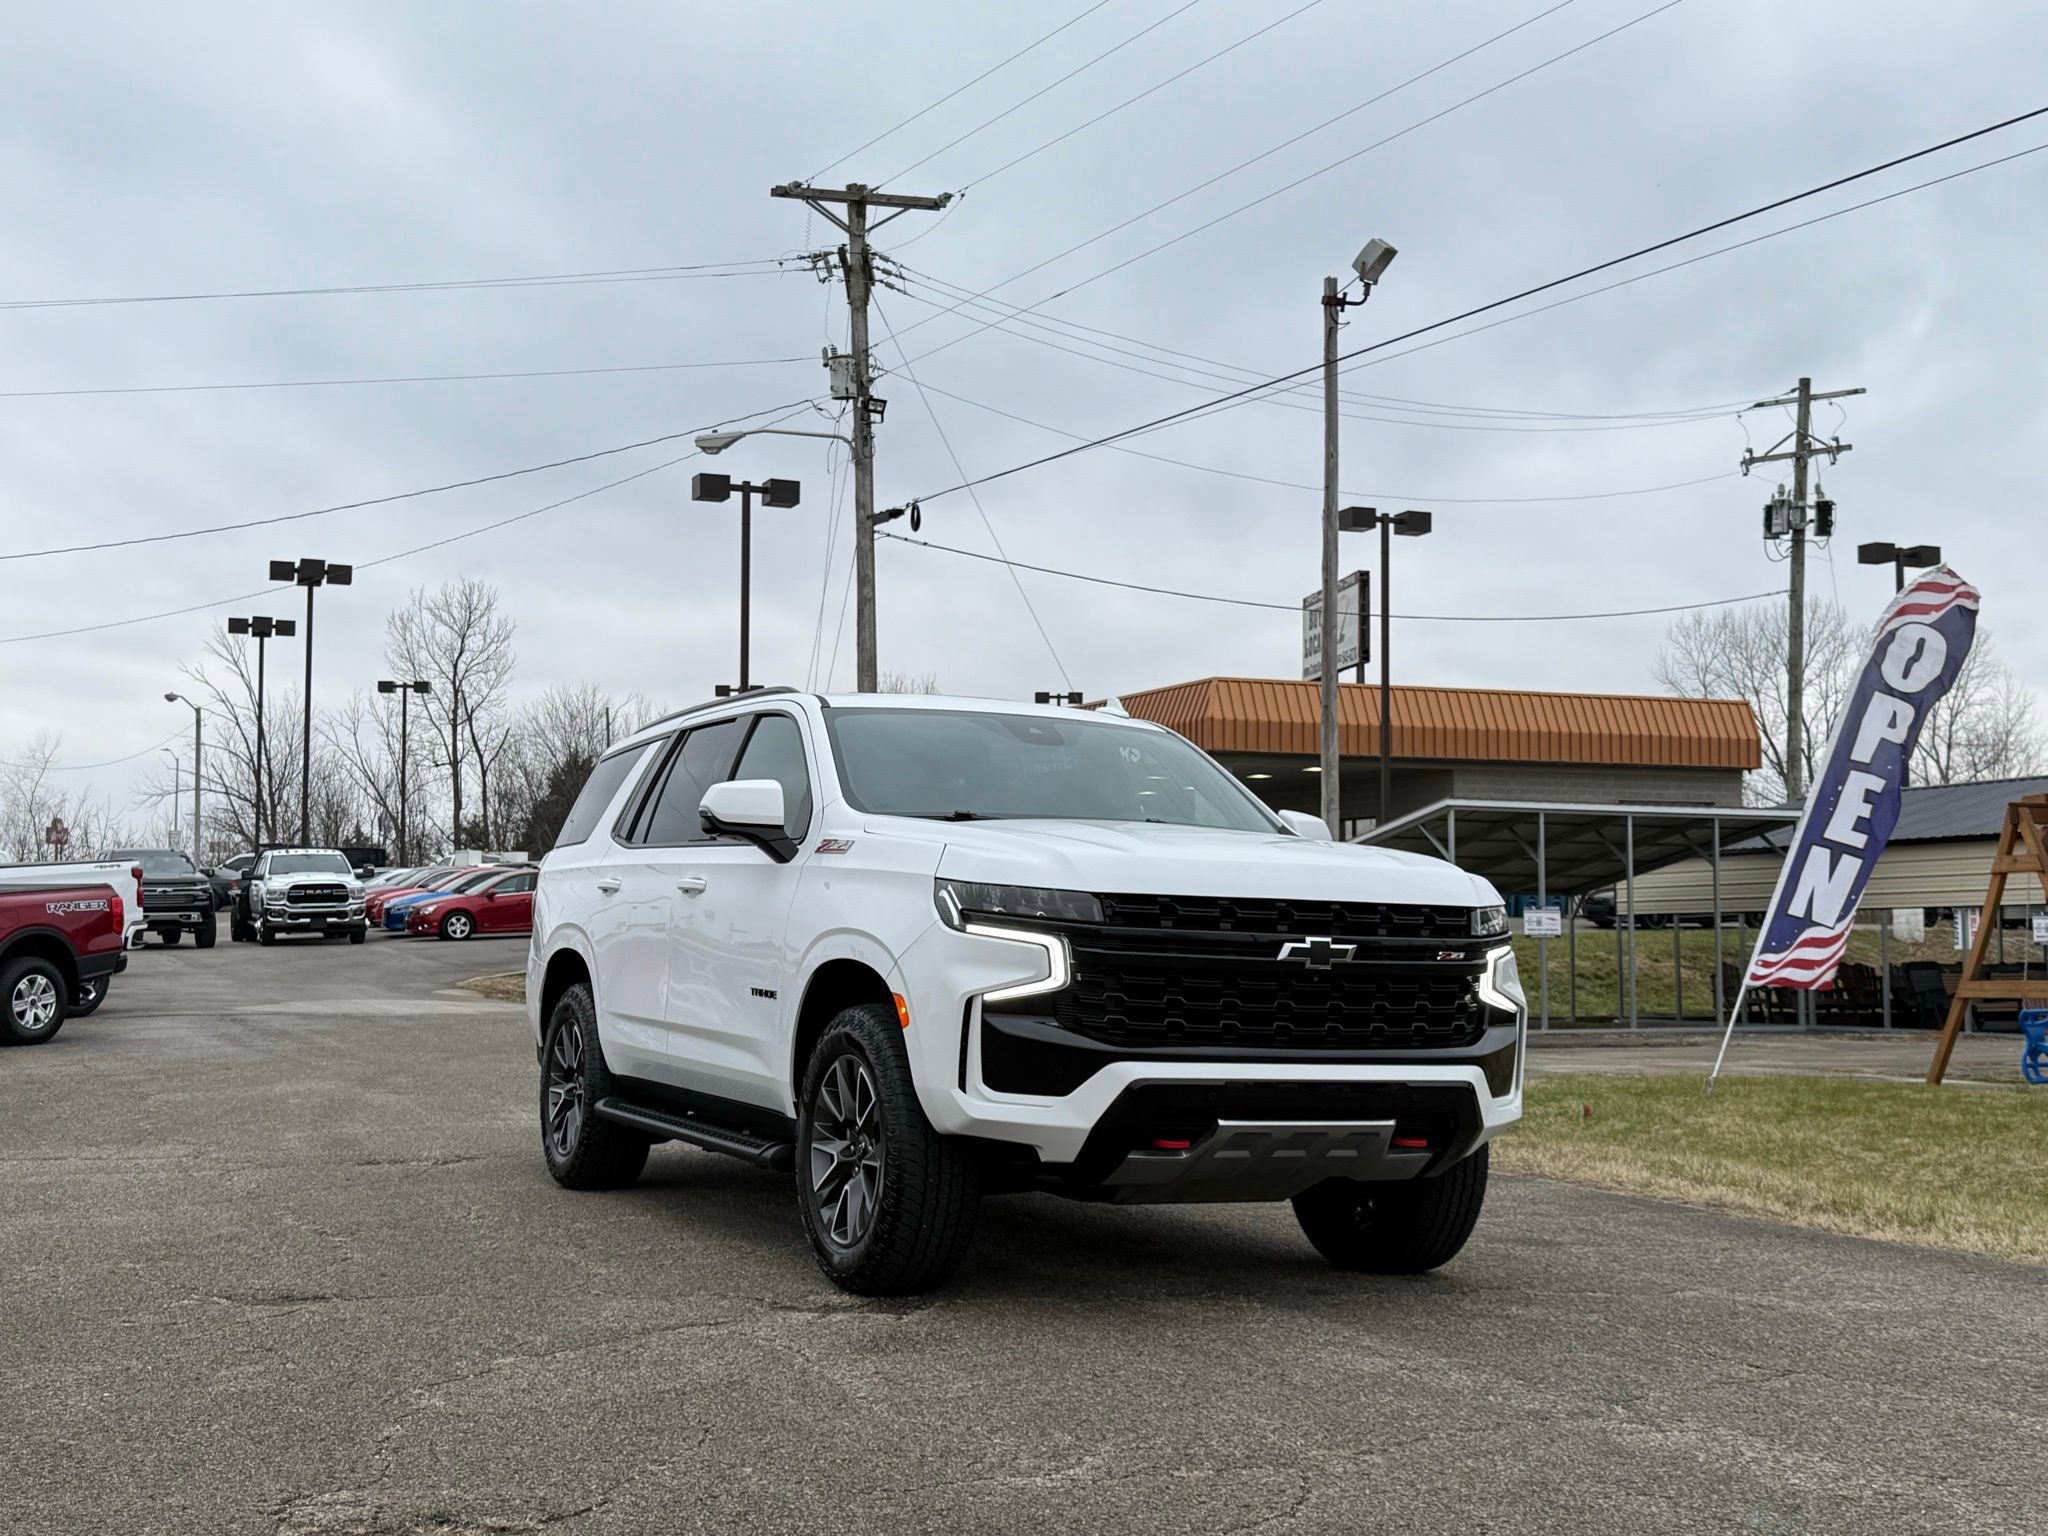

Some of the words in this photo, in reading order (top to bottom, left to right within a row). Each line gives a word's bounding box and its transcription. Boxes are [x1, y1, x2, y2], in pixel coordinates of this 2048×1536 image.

[1787, 621, 1948, 929] OPEN
[46, 899, 110, 916] RANGER
[750, 986, 778, 1000] TAHOE
